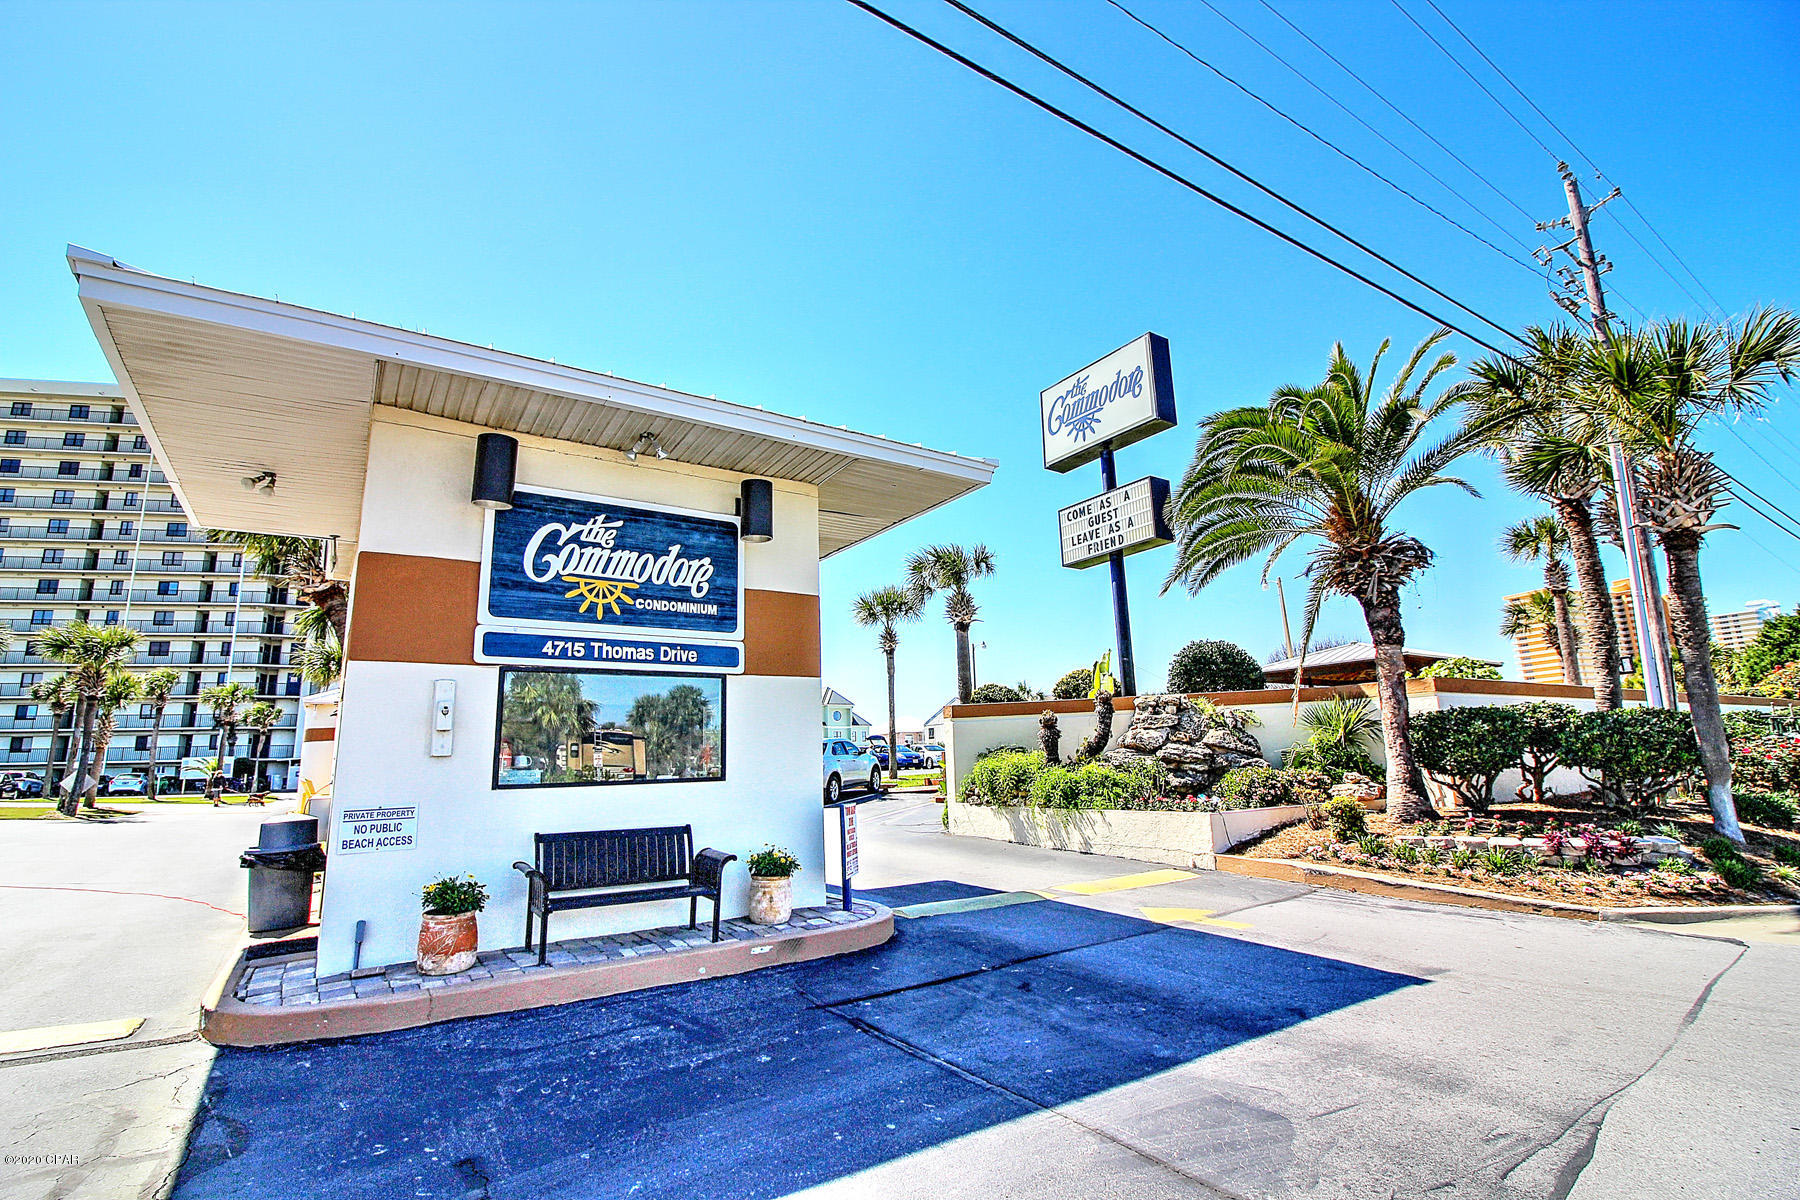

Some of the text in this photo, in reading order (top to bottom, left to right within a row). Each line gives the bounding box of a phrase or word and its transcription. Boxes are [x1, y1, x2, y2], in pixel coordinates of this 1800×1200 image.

[1070, 374, 1090, 399] the
[1047, 365, 1144, 436] Commodore
[1066, 490, 1131, 522] COME AS A
[1088, 507, 1119, 528] GUEST
[579, 513, 624, 548] the
[1071, 517, 1135, 547] LEAVE AS A
[1087, 534, 1125, 555] FRIEND
[522, 522, 714, 599] Commodore
[635, 598, 719, 616] CONDOMINIUM
[541, 640, 699, 662] 4715 Thomas Drive
[343, 809, 415, 820] PRIVATE PROPERTY
[353, 822, 403, 835] NO PUBLIC
[341, 835, 413, 850] BEACH ACCESS
